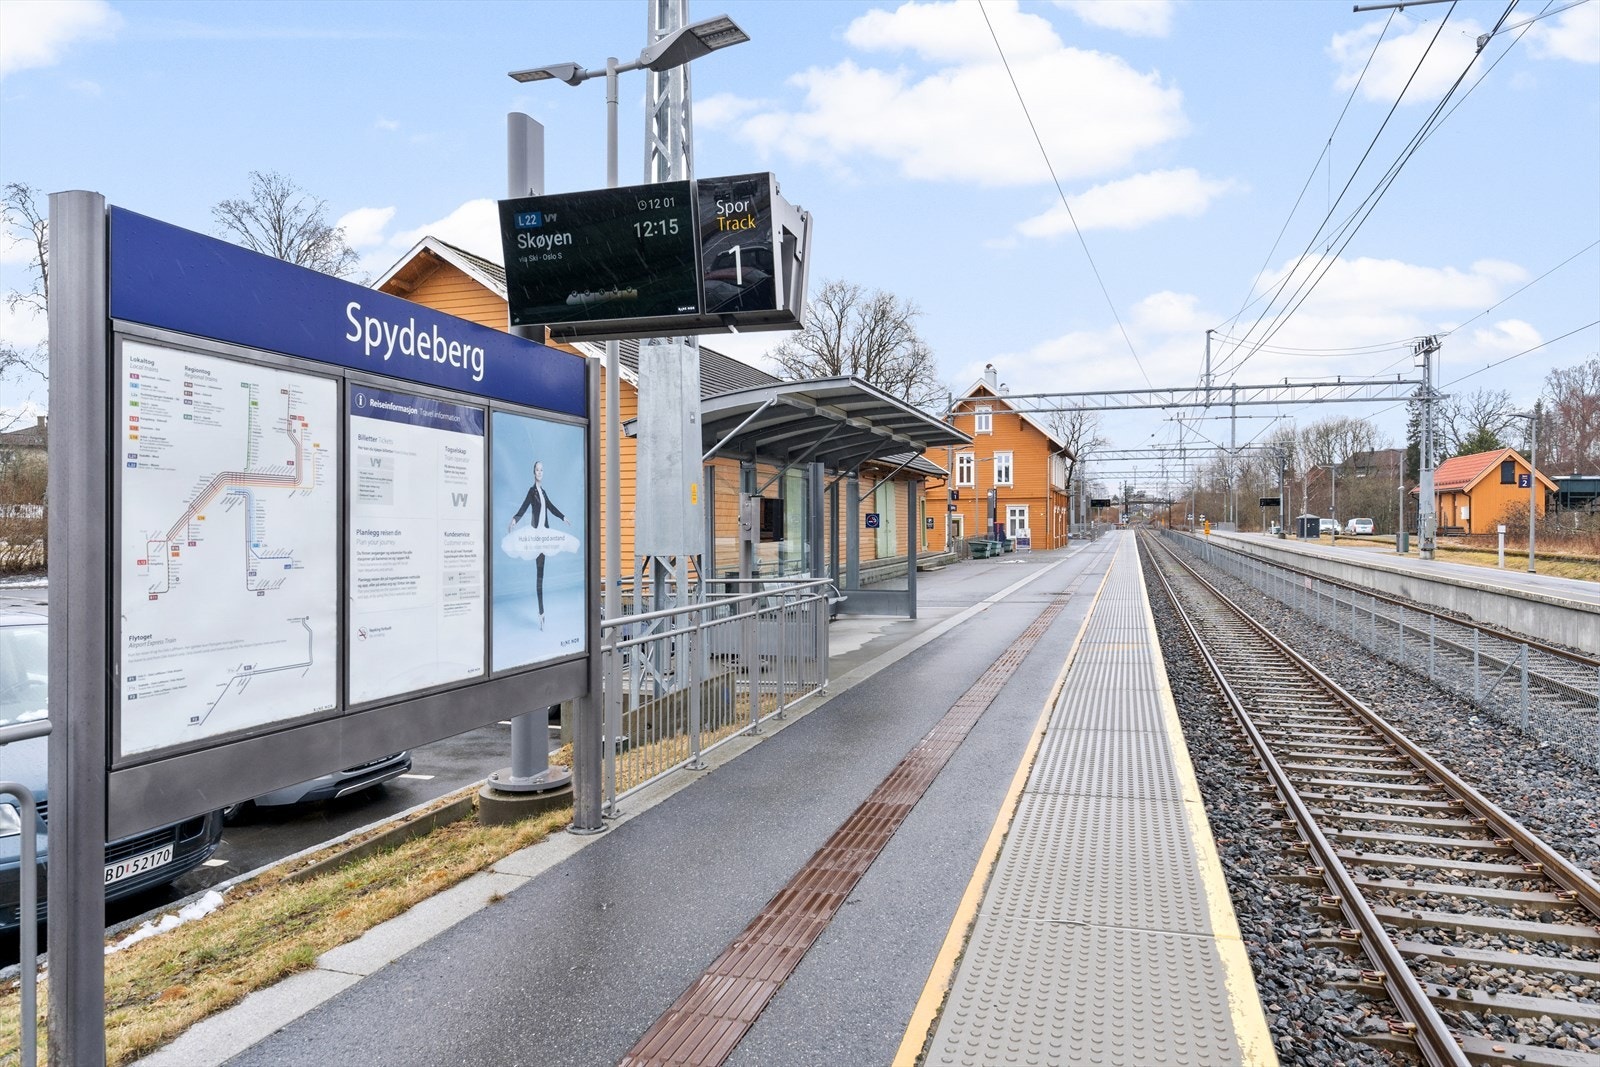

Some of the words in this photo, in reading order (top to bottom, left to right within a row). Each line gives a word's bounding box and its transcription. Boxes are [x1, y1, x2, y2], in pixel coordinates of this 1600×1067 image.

[648, 198, 661, 209] 12
[663, 197, 675, 208] 01
[716, 199, 750, 217] Spor
[518, 214, 537, 226] L22
[716, 213, 756, 231] Track
[633, 218, 679, 238] 12:15
[517, 232, 573, 251] Skøyen
[529, 254, 538, 262] Ski
[542, 253, 557, 261] Oslo
[557, 252, 563, 260] S
[728, 244, 743, 285] 1
[345, 301, 485, 382] Spydeberg
[129, 355, 155, 367] Lokaltog
[184, 365, 211, 377] Regiontog
[184, 372, 205, 381] Regional
[369, 398, 418, 415] Reiseinformasjon
[419, 407, 434, 417] Travel
[434, 409, 461, 422] information
[358, 433, 378, 443] Billetter
[1522, 479, 1528, 487] 2
[356, 529, 380, 538] Planlegg
[128, 633, 153, 642] Flytoget
[128, 641, 147, 649] Airport
[147, 639, 164, 647] Express
[105, 865, 124, 882] BD
[132, 849, 170, 873] 52170
